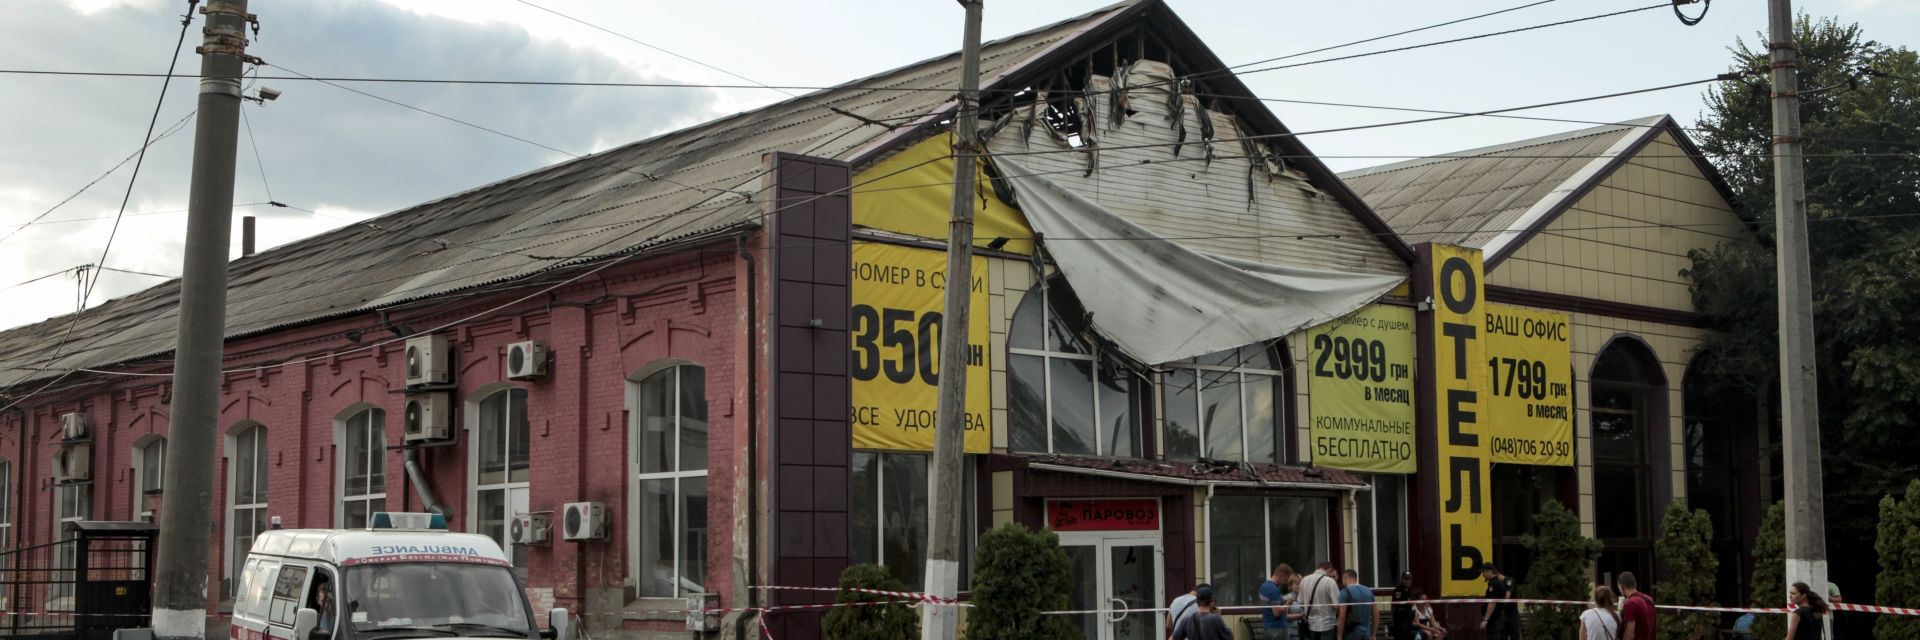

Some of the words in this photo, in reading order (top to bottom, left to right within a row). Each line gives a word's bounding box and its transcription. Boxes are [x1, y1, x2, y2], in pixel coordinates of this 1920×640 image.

[916, 269, 926, 287] В
[1378, 319, 1410, 331] душем
[1486, 313, 1519, 336] ВАШ
[1523, 318, 1566, 342] ОФИС
[851, 304, 944, 387] 350
[1314, 333, 1386, 383] 2999
[1390, 363, 1408, 381] грн
[1489, 356, 1546, 400] 1799
[1550, 382, 1567, 398] грн
[1365, 386, 1372, 401] в
[1375, 387, 1410, 406] месяц
[894, 408, 985, 432] УДОВА
[1440, 256, 1483, 582] ОТЕЛЬ
[1527, 404, 1533, 417] в
[1536, 404, 1568, 421] месяц
[1316, 415, 1410, 435] КОММУНАЛЬНЫЕ
[1317, 436, 1411, 461] БЕСПЛАТНО
[1491, 436, 1536, 458] (048)706
[1540, 440, 1553, 457] 20
[1556, 441, 1569, 457] 30
[1082, 508, 1155, 521] ПАРОВОЗ
